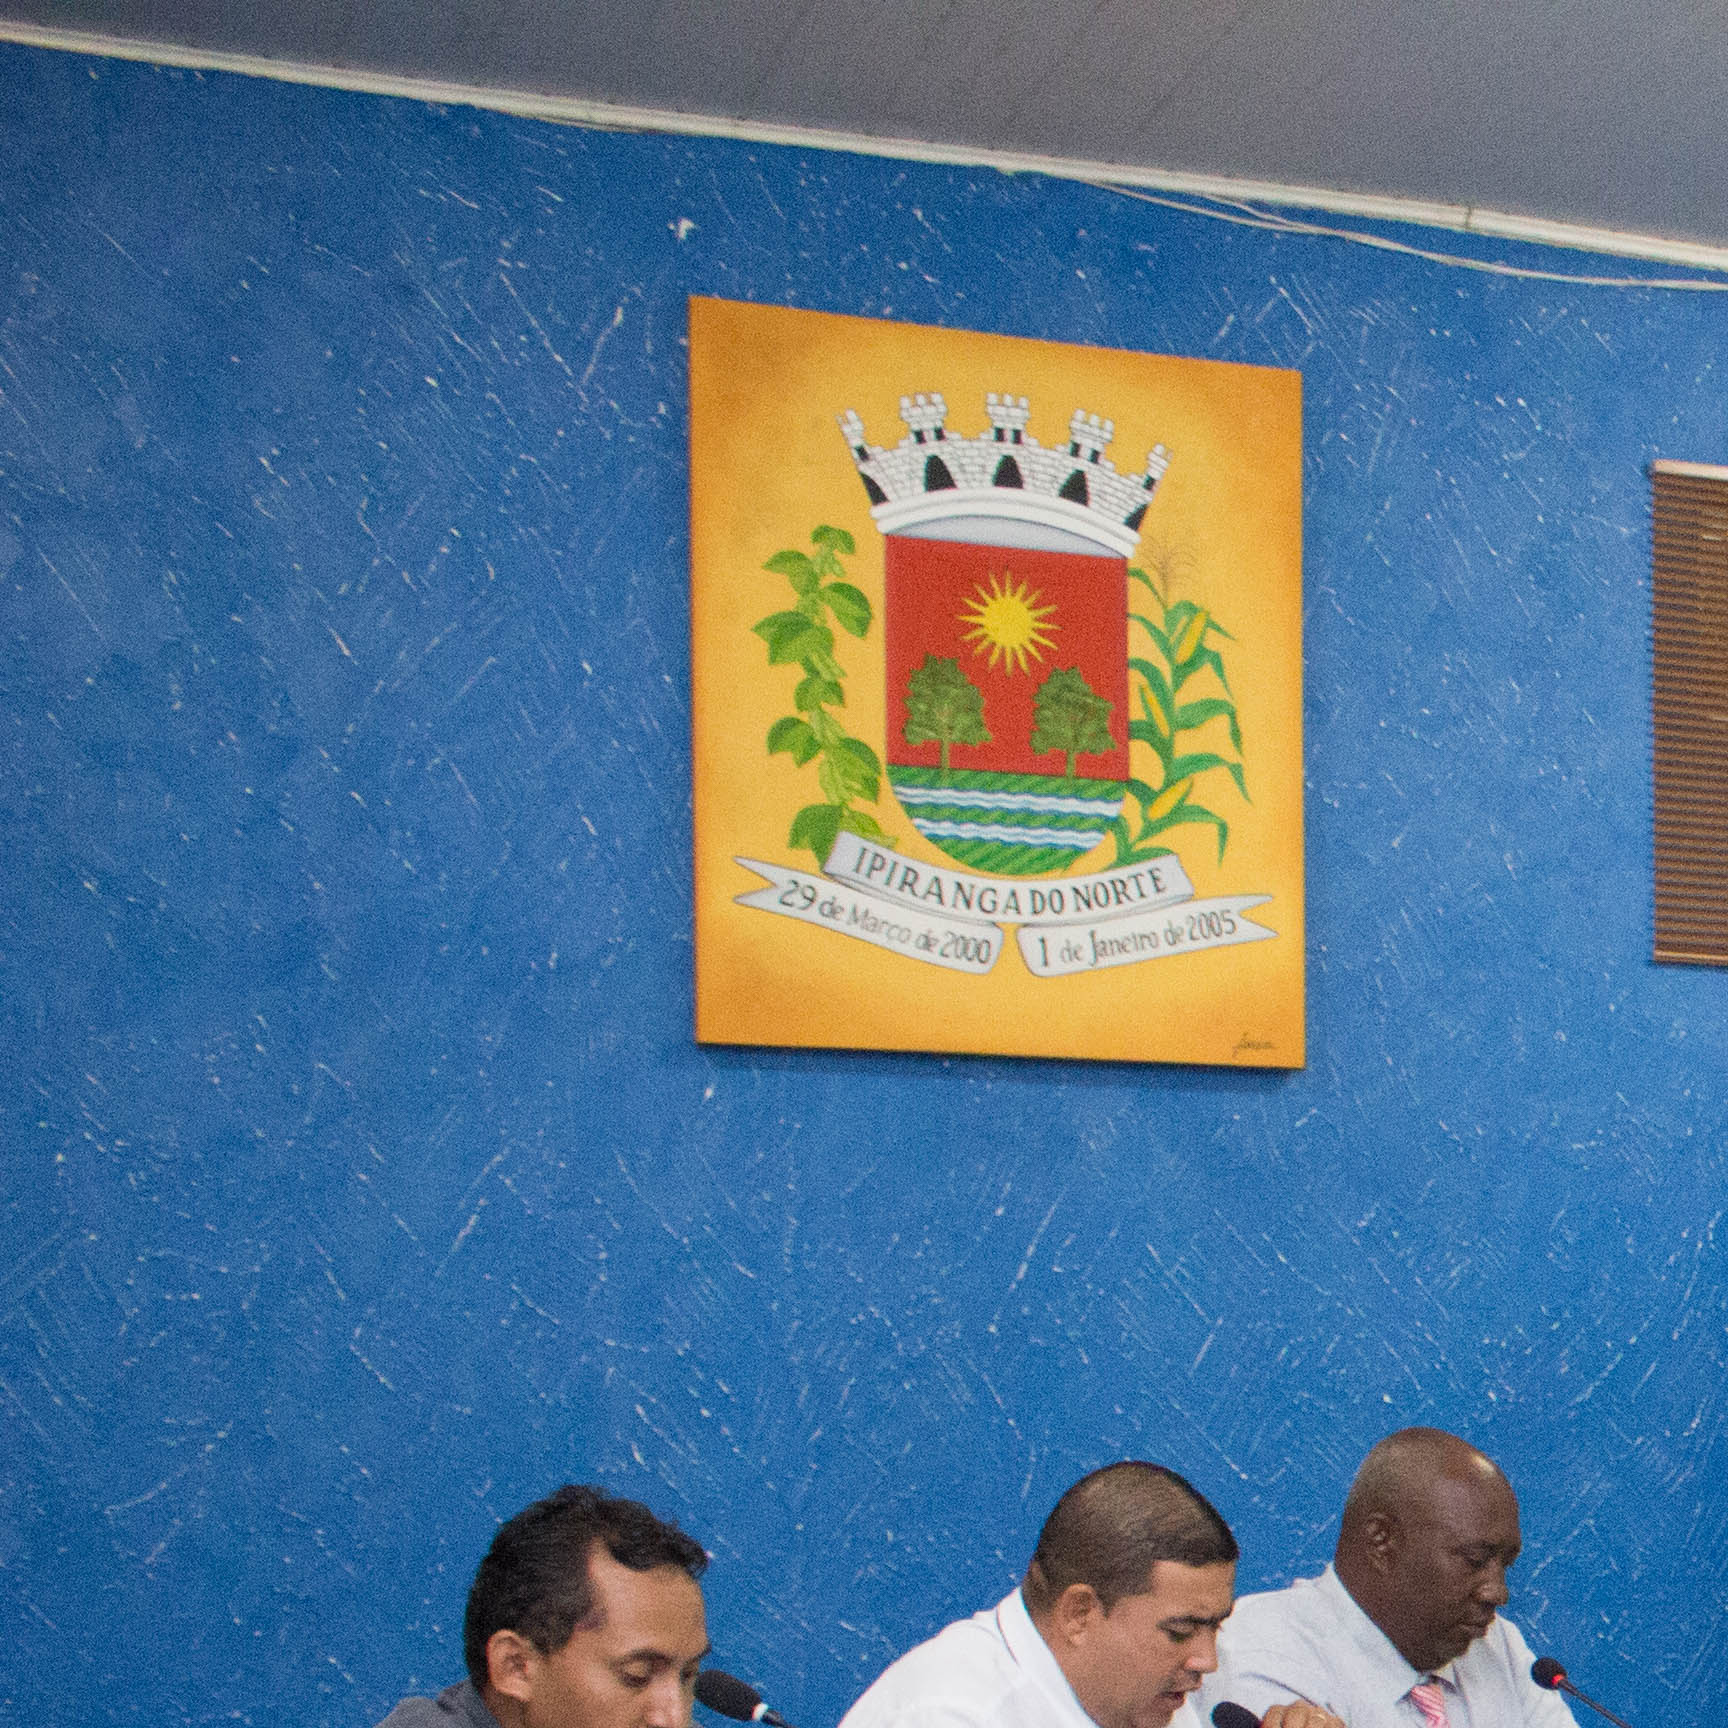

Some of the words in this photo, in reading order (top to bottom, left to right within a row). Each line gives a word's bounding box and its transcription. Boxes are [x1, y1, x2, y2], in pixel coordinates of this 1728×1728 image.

[853, 847, 1022, 915] IPIRANGA
[1031, 887, 1064, 915] DO
[1071, 867, 1167, 912] NORTE
[777, 879, 817, 911] 29
[818, 895, 844, 919] de
[848, 904, 911, 946] Março
[915, 928, 940, 951] de
[940, 930, 991, 963] 2000
[1038, 936, 1049, 967] 1
[1060, 939, 1083, 963] de
[1088, 928, 1159, 966] Janeiro
[1163, 921, 1184, 945] de
[1187, 909, 1237, 939] 2005
